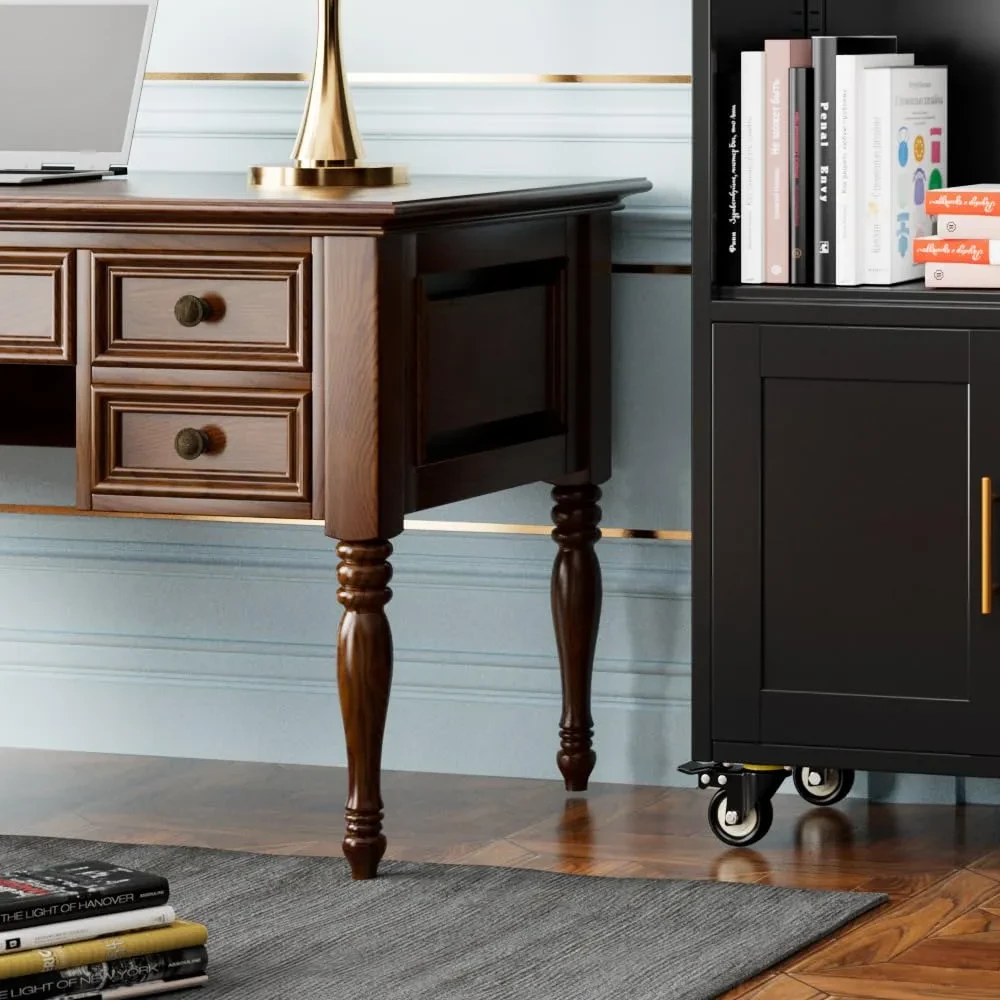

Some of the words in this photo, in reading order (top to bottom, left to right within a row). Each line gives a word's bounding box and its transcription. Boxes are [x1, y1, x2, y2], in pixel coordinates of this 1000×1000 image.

[819, 101, 830, 147] Penal
[818, 165, 830, 203] Envy
[1, 910, 24, 923] THE
[25, 904, 59, 920] LIGHT
[60, 902, 77, 913] OF
[78, 893, 135, 911] HANOVER
[10, 981, 55, 998] LIGHT
[56, 977, 78, 990] OF
[79, 969, 117, 986] NEW
[117, 963, 160, 979] YORK
